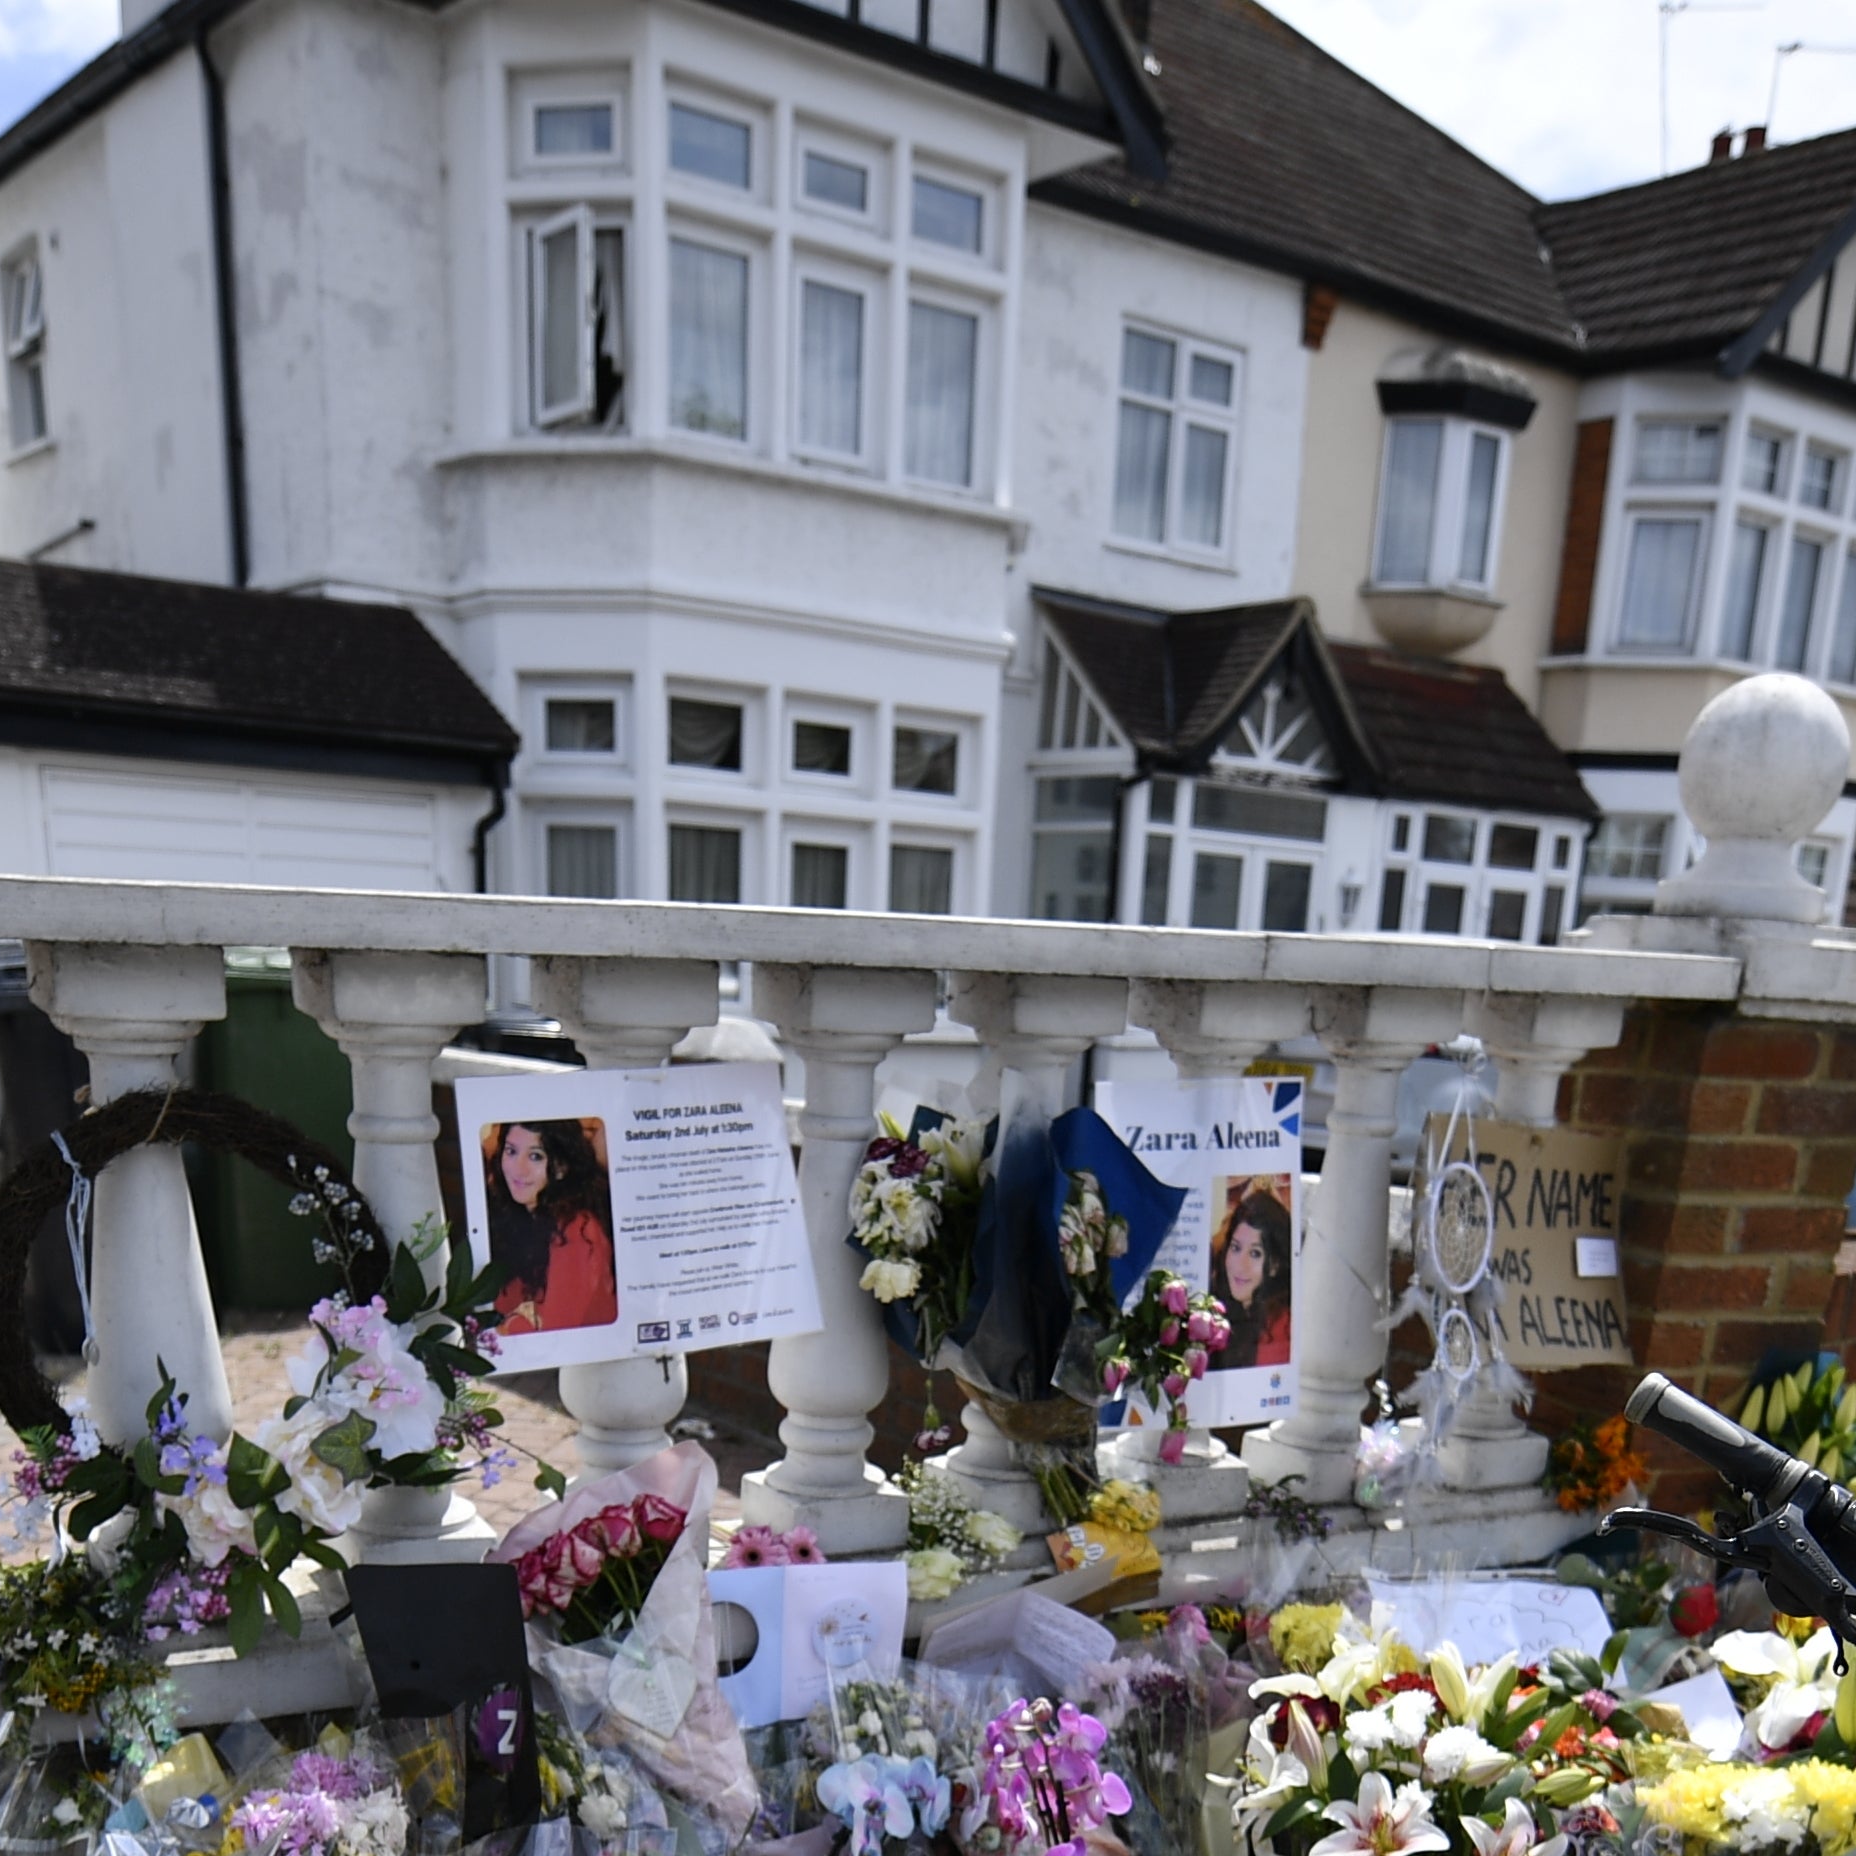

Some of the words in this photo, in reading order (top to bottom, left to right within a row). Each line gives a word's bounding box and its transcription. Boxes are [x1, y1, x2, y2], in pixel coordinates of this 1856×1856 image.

[633, 1109, 661, 1121] VIGIL
[663, 1108, 682, 1119] FOR
[685, 1105, 707, 1117] ZARA
[710, 1102, 743, 1116] ALEENA
[625, 1127, 672, 1142] Saturday
[674, 1126, 690, 1138] 2nd
[692, 1124, 709, 1138] July
[711, 1124, 719, 1134] at
[721, 1121, 754, 1135] 1:30pm
[1126, 1125, 1198, 1152] Zara
[1206, 1122, 1280, 1150] Aleena
[1527, 1168, 1615, 1229] NAME
[1488, 1248, 1533, 1287] WAS
[1519, 1293, 1630, 1350] ALEENA
[496, 1709, 518, 1756] Z
